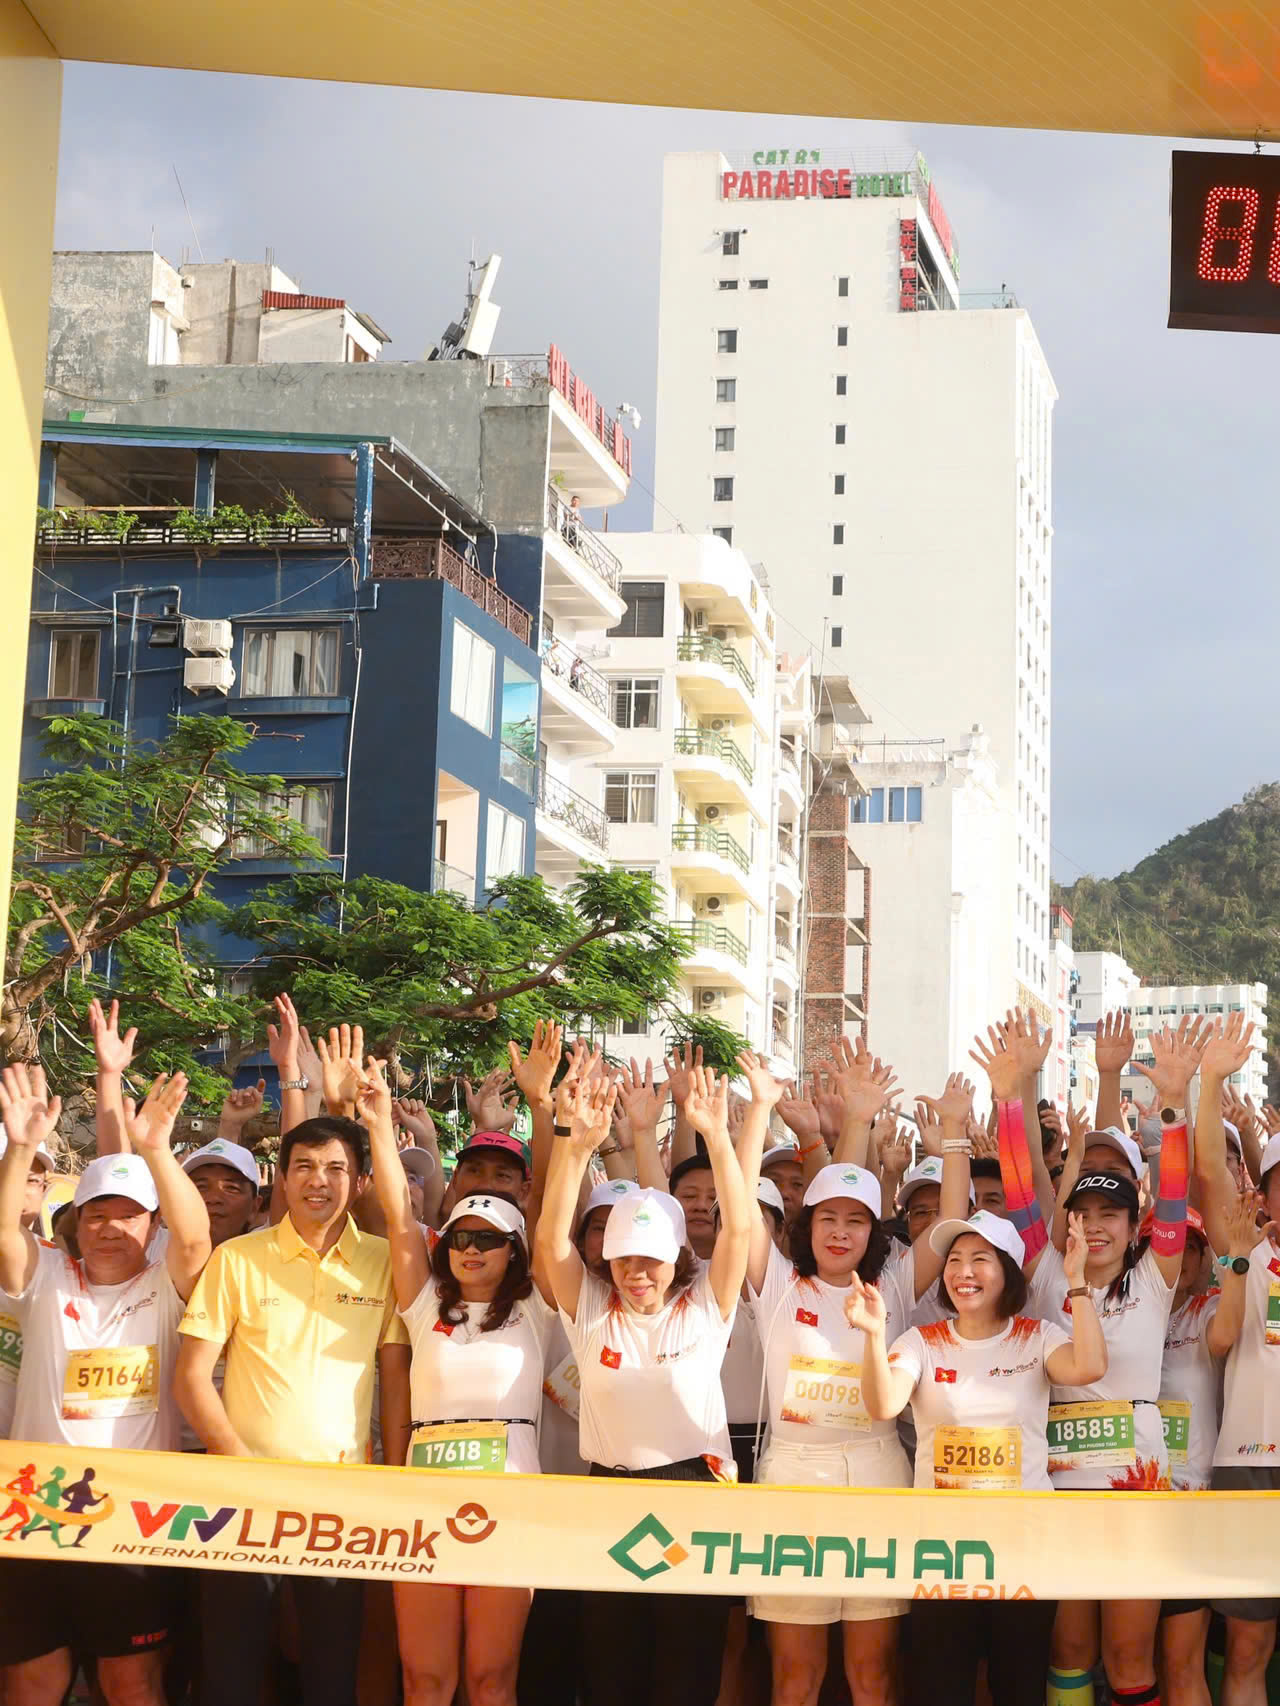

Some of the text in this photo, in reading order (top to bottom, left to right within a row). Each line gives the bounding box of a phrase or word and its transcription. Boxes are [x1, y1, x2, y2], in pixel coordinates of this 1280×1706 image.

[722, 168, 913, 199] PARADISE HOTEL
[77, 1365, 144, 1388] 57164
[794, 1379, 861, 1406] 00098
[1055, 1417, 1115, 1442] 18585
[425, 1439, 482, 1465] 17618
[943, 1444, 1005, 1467] 52186
[129, 1500, 444, 1560] VTV LPBank
[111, 1543, 436, 1575] INTERNATIONAL MARATHON
[913, 1538, 996, 1580] AN
[912, 1582, 1038, 1601] MEDIA
